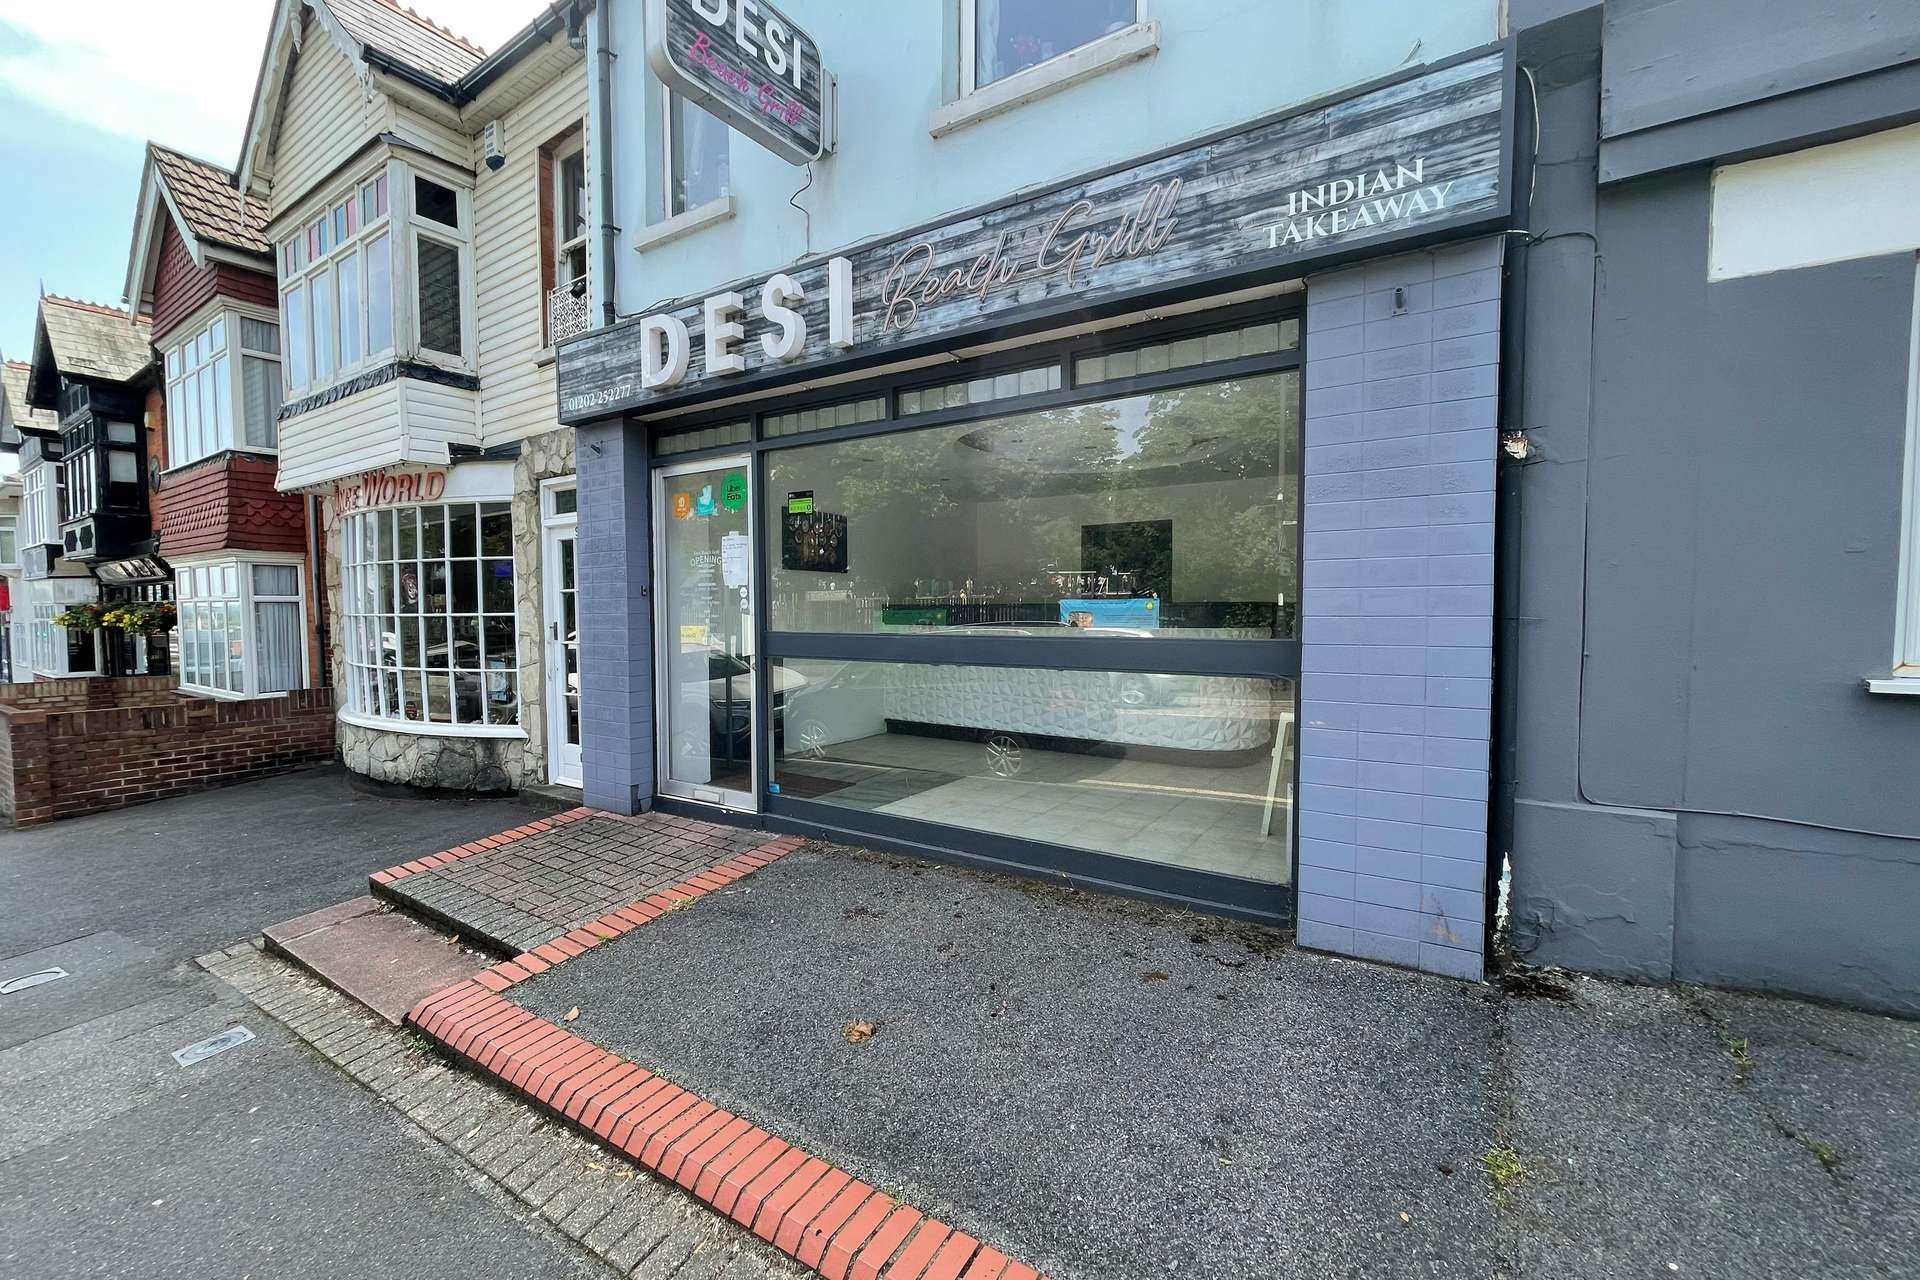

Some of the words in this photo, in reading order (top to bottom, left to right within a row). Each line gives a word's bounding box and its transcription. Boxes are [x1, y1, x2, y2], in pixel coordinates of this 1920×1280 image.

[688, 31, 751, 94] Beach
[757, 80, 805, 126] Grill
[1287, 157, 1426, 217] INDIAN
[1262, 181, 1455, 249] TAKEAWAY
[640, 256, 854, 390] DESI
[881, 228, 1020, 335] Beach
[1037, 175, 1184, 289] Grill
[568, 393, 595, 411] 01202
[597, 384, 631, 404] 252277
[335, 485, 361, 514] NCE
[360, 468, 446, 507] WORLD
[727, 493, 742, 501] Eats
[690, 554, 722, 567] OPENING
